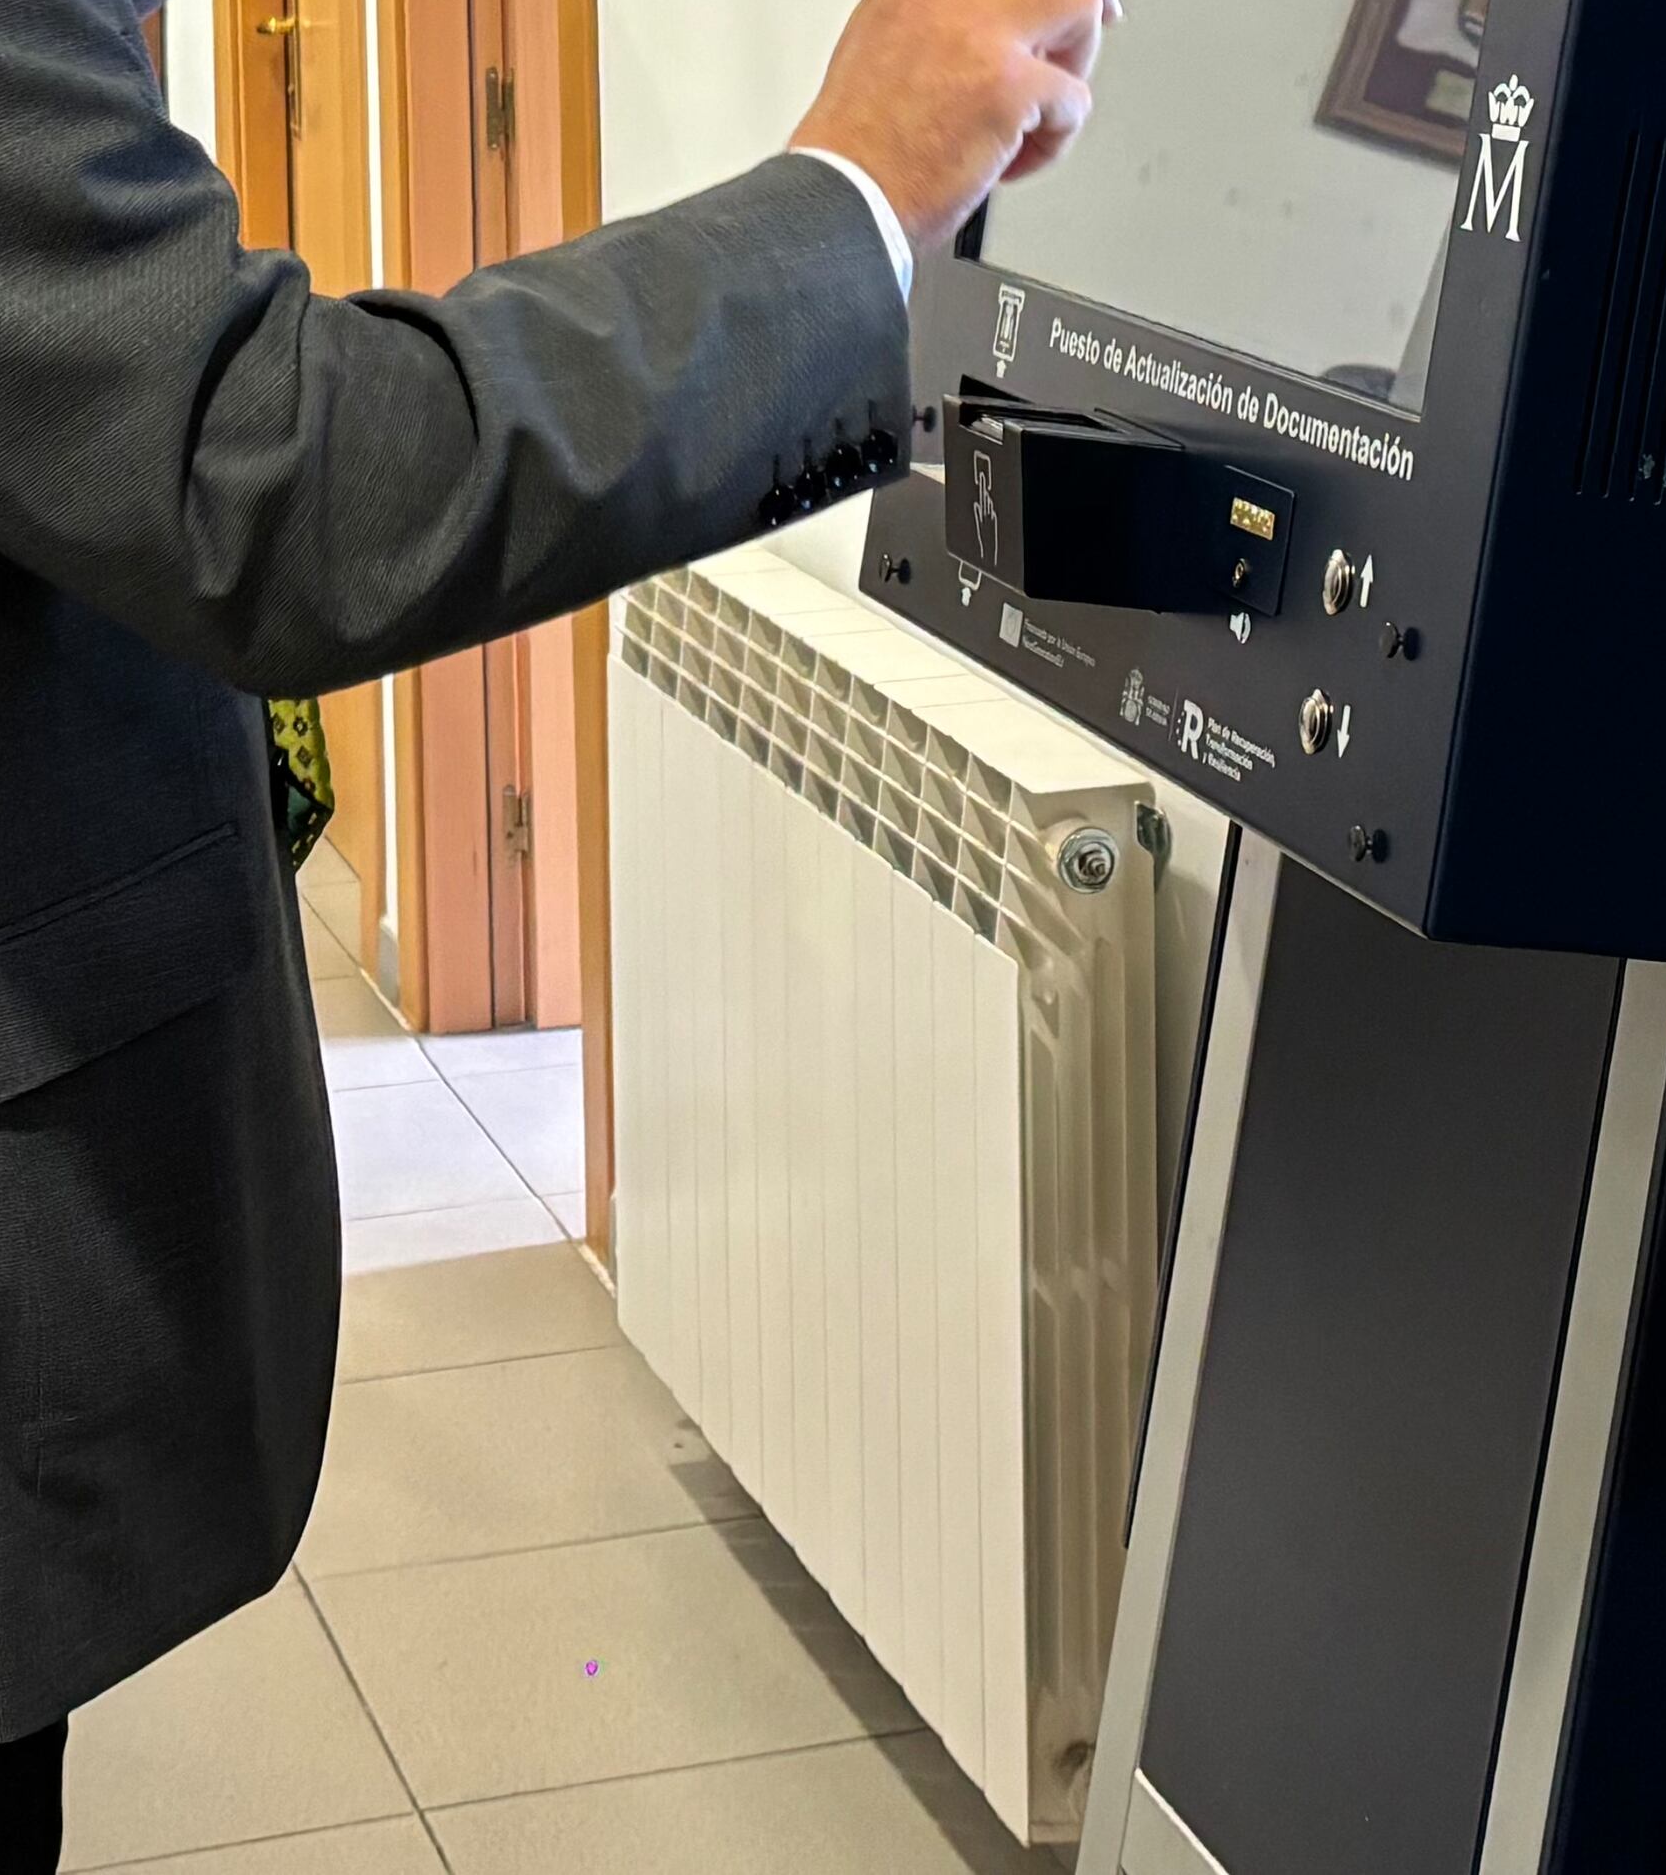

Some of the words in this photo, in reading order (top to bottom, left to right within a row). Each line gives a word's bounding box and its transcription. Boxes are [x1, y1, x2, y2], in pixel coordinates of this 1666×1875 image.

[1049, 317, 1100, 365] Puesto
[1103, 338, 1122, 374] de
[1124, 345, 1232, 415] Actualización
[1237, 386, 1259, 423] de
[1263, 392, 1414, 480] Documentación
